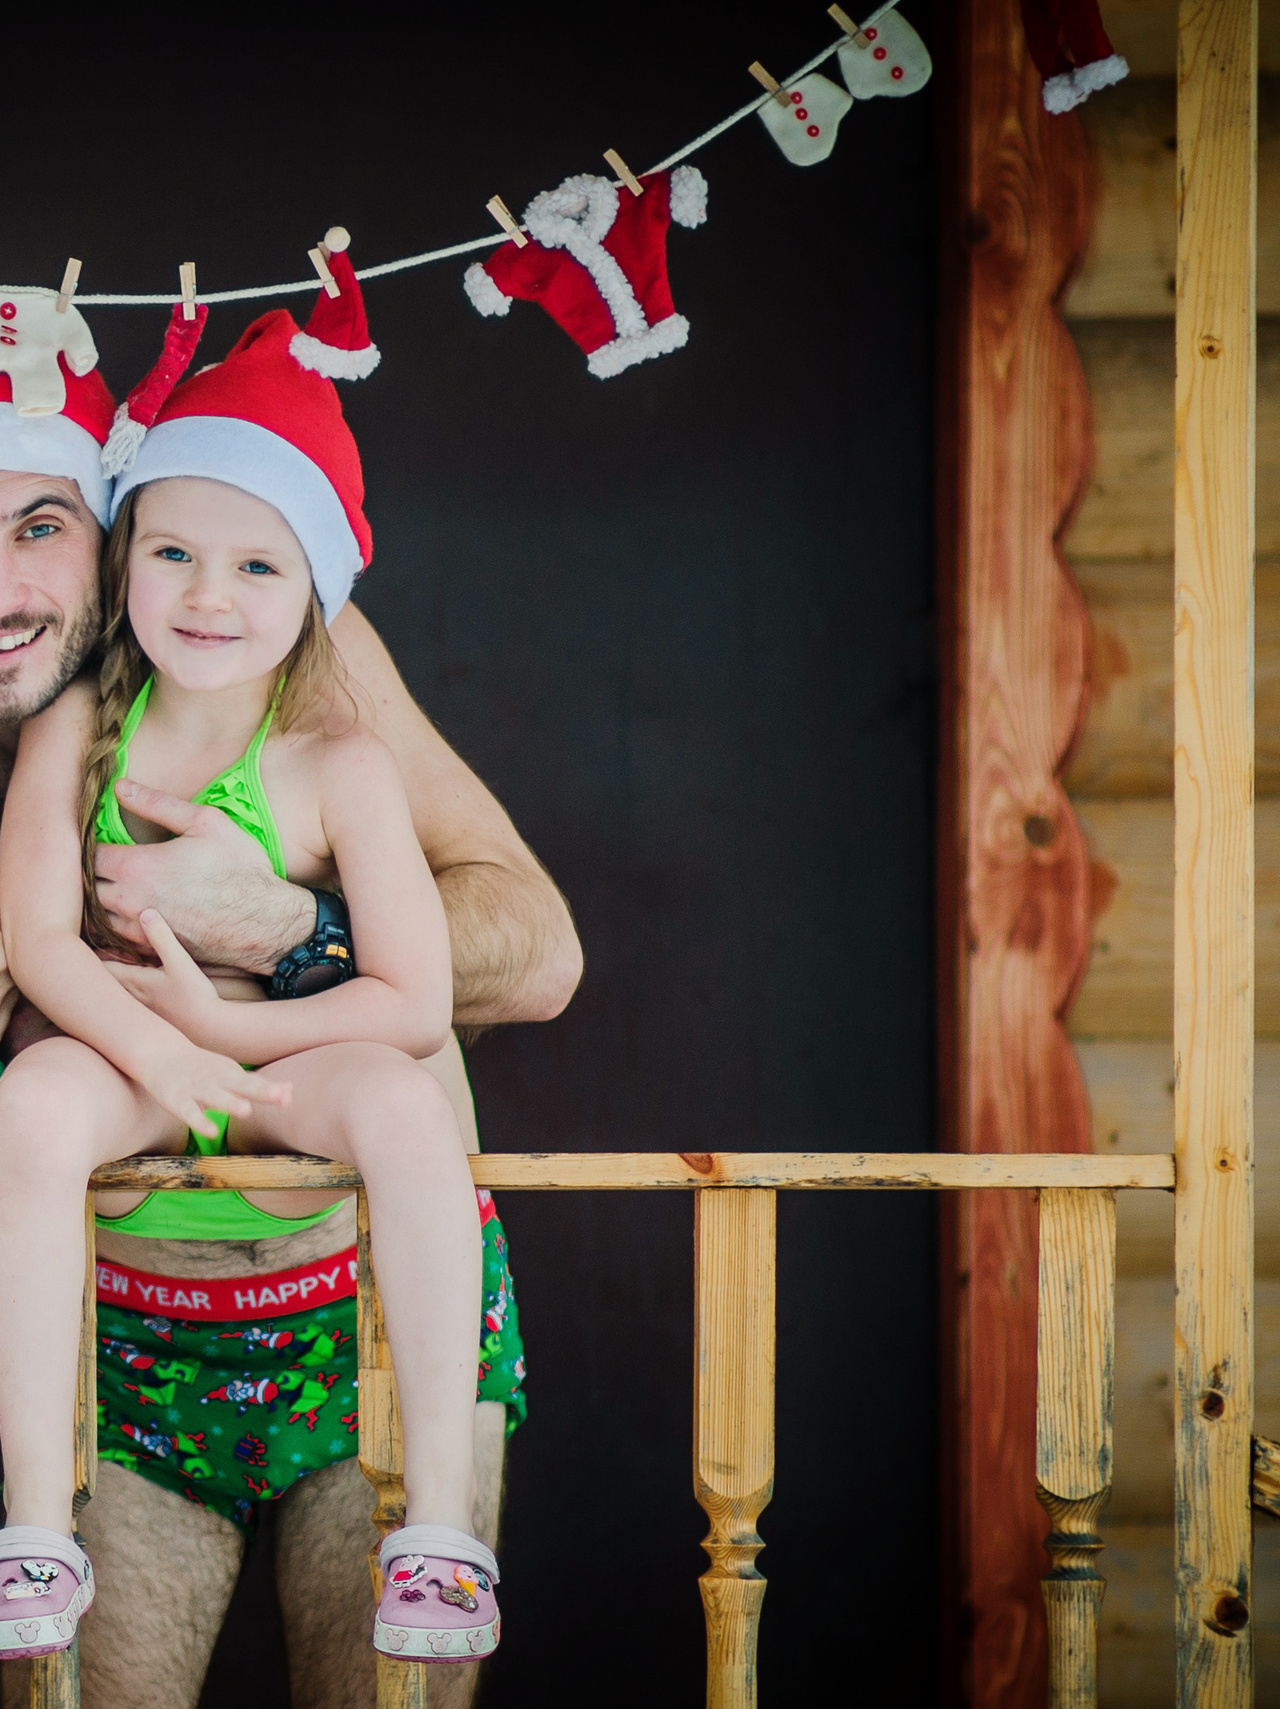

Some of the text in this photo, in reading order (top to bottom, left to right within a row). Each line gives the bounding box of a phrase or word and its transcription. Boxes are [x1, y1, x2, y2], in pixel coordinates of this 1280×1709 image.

[96, 1265, 211, 1311] EW YEAR
[234, 1265, 341, 1311] HAPPY
